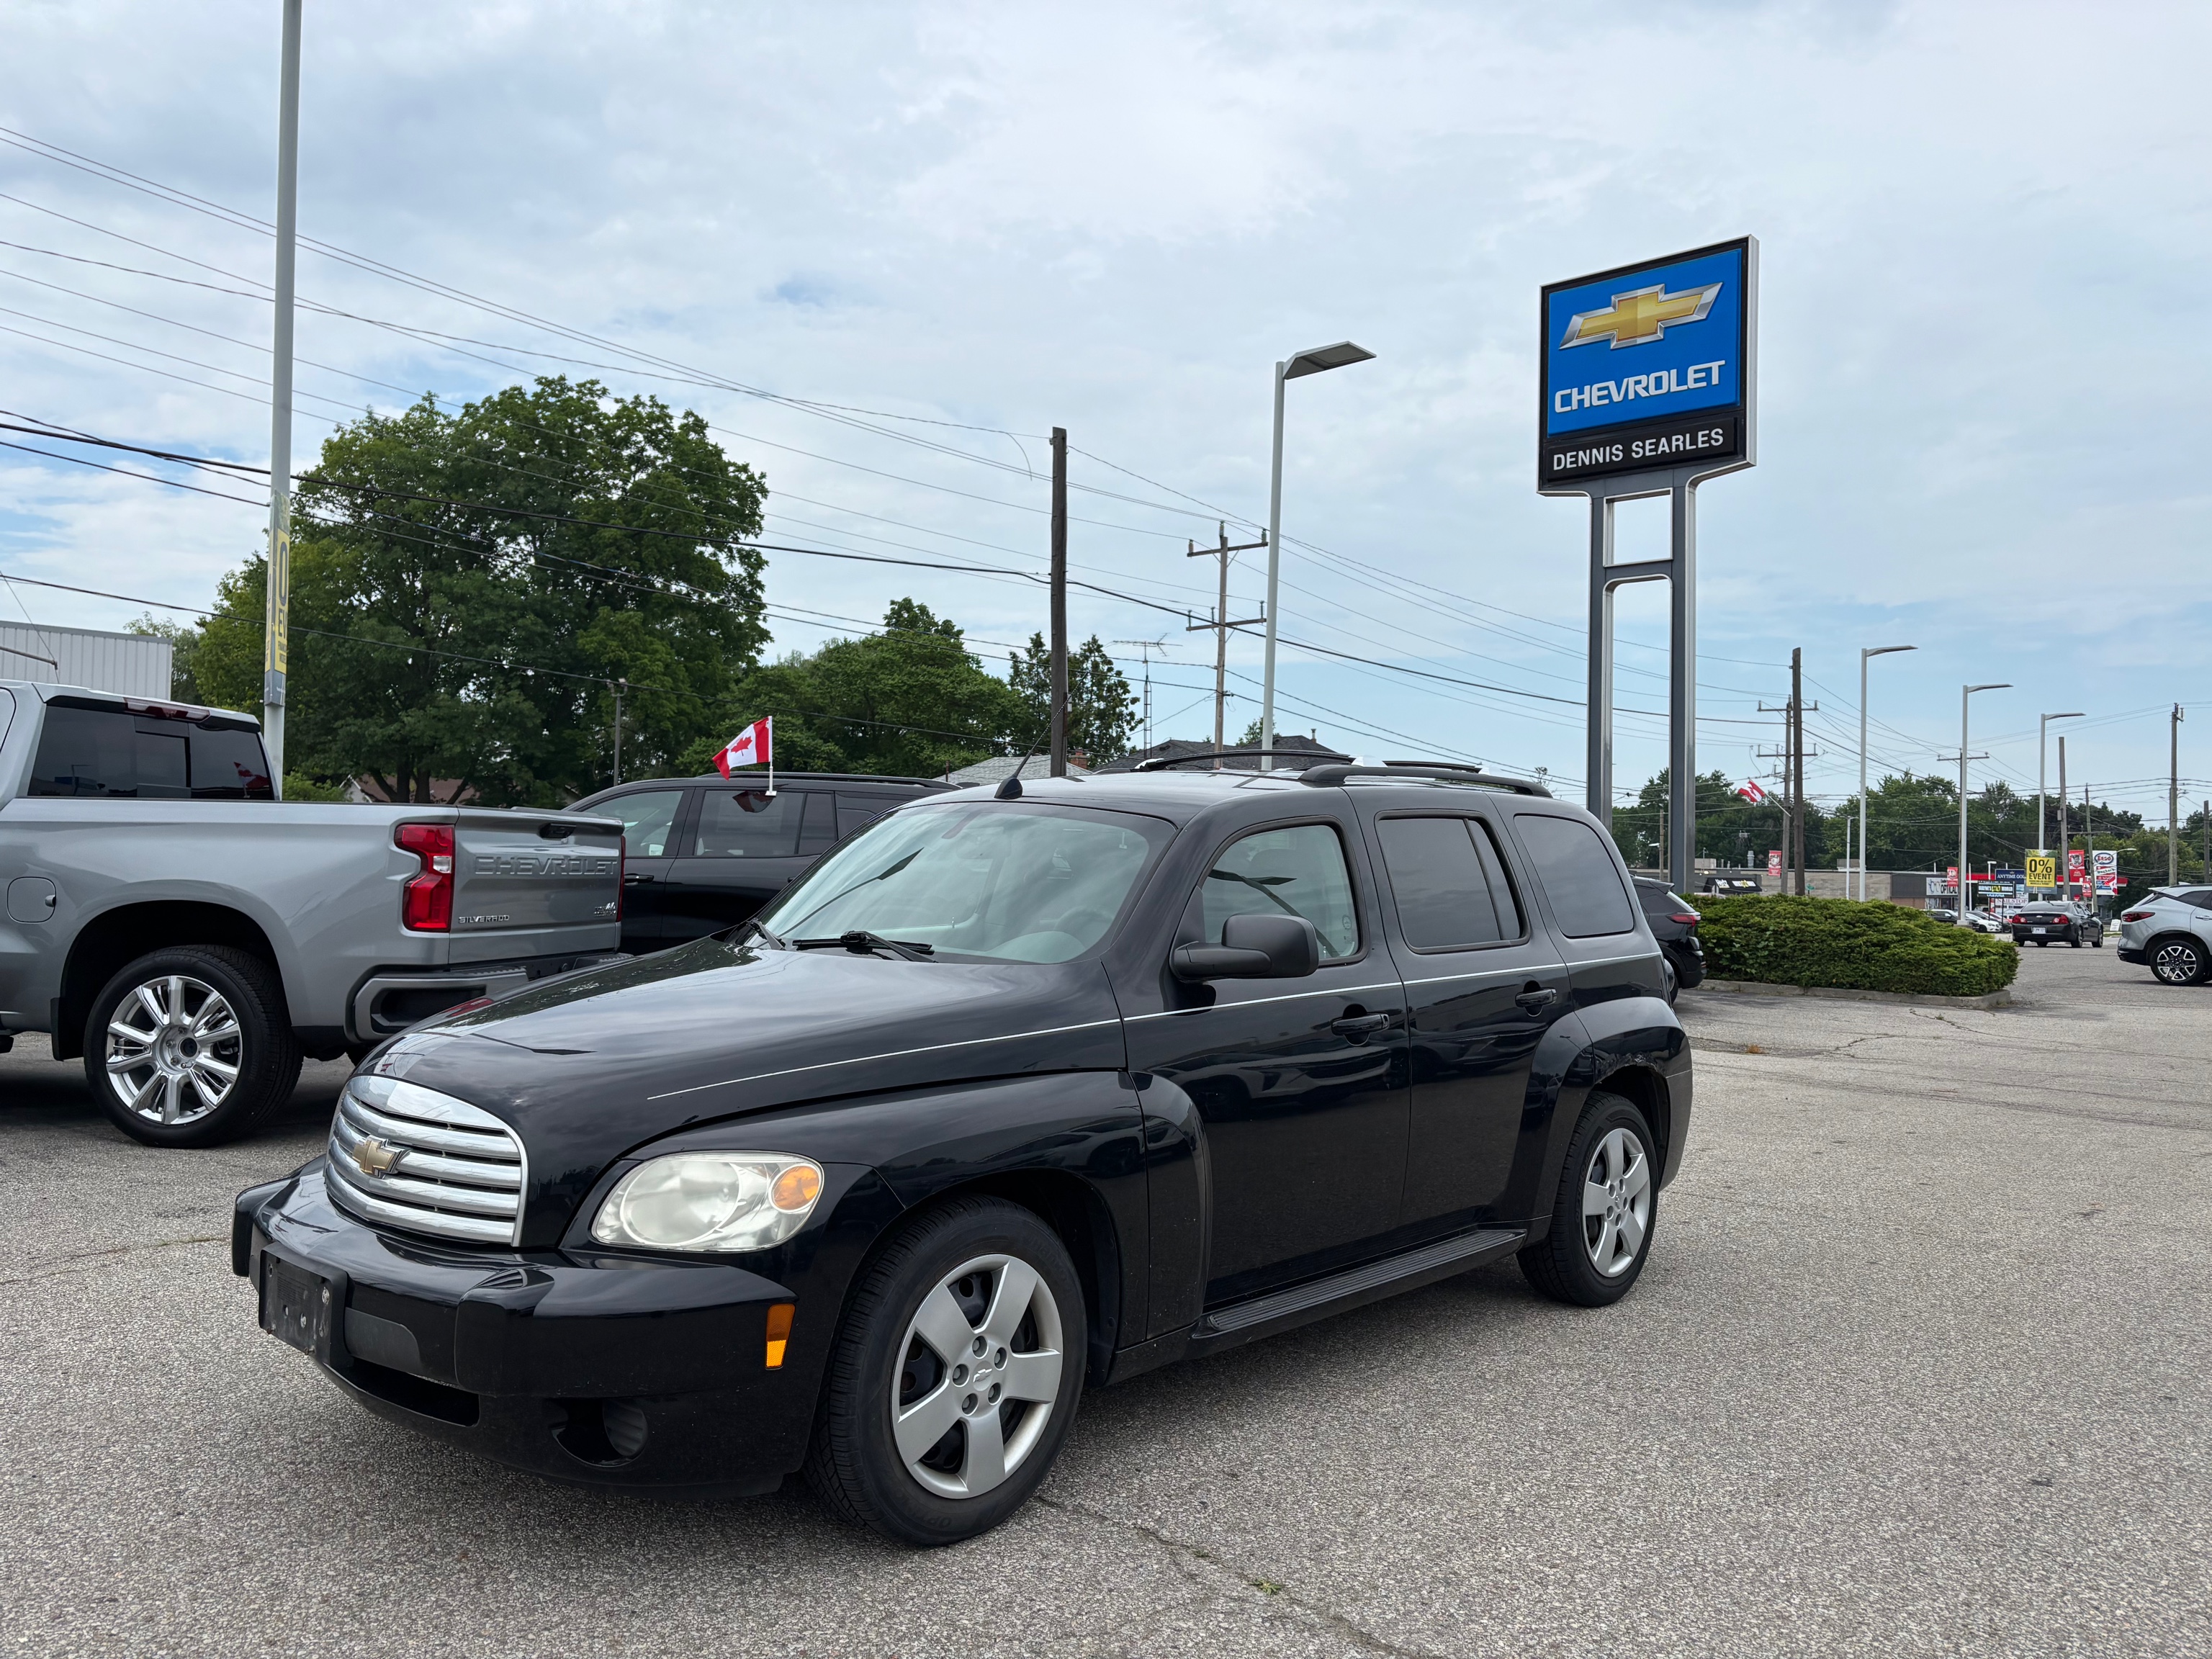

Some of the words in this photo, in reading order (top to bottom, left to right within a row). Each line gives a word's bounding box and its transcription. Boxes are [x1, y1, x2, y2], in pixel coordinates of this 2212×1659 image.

[1555, 360, 1726, 413] CHEVROLET
[1553, 444, 1624, 472] DENNIS
[1631, 428, 1724, 459] SEARLES
[475, 855, 617, 876] CHEVROLET
[2029, 859, 2052, 873] 0%
[459, 914, 510, 924] SILVERADO
